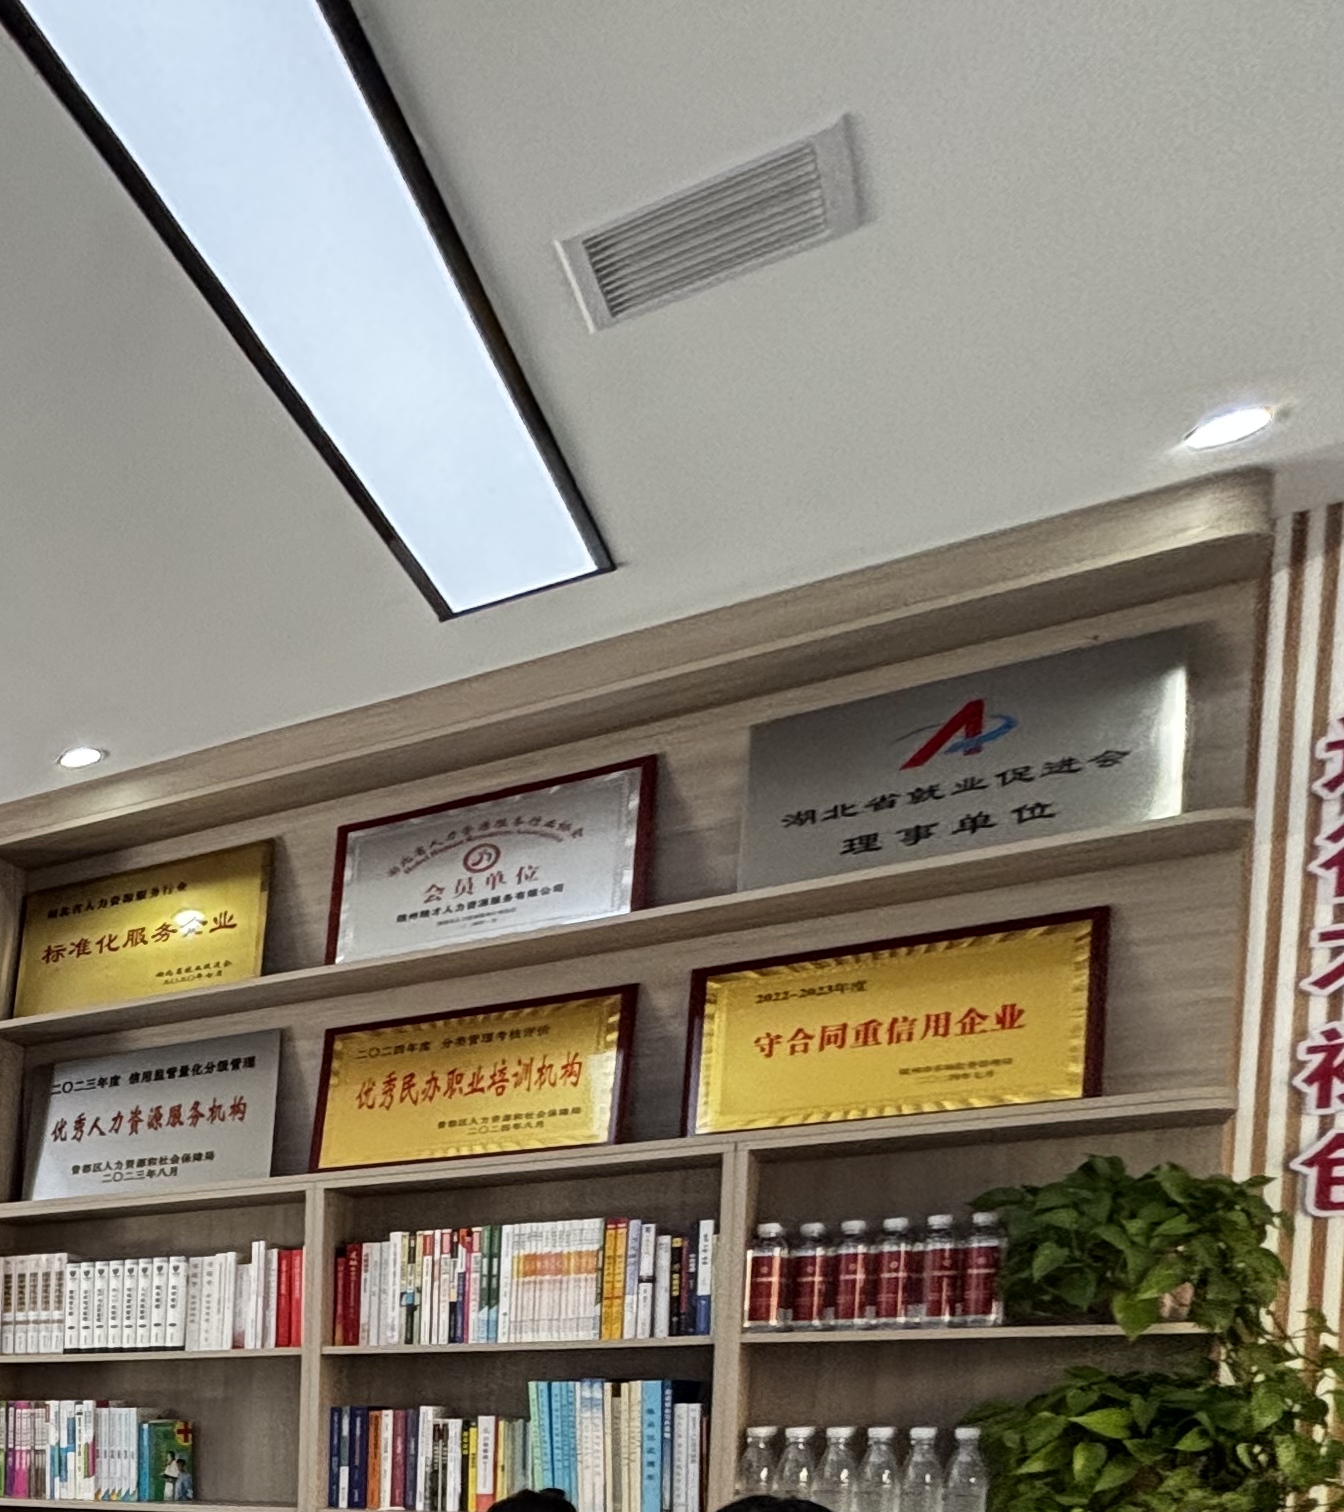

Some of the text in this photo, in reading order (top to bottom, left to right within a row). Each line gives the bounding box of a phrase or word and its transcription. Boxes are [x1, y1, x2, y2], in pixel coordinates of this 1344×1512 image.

[781, 749, 1131, 828] 湖北省就业促进会
[839, 801, 1057, 855] 理事单位
[422, 864, 541, 904] 会员单位
[41, 910, 239, 965] 标准化服务企业
[753, 1002, 1026, 1058] 守合同重信用企业
[51, 1075, 121, 1095] 二〇二三年度
[356, 1051, 583, 1111] 优秀民办职业培训机构
[50, 1095, 248, 1143] 优秀人力资源服务机构
